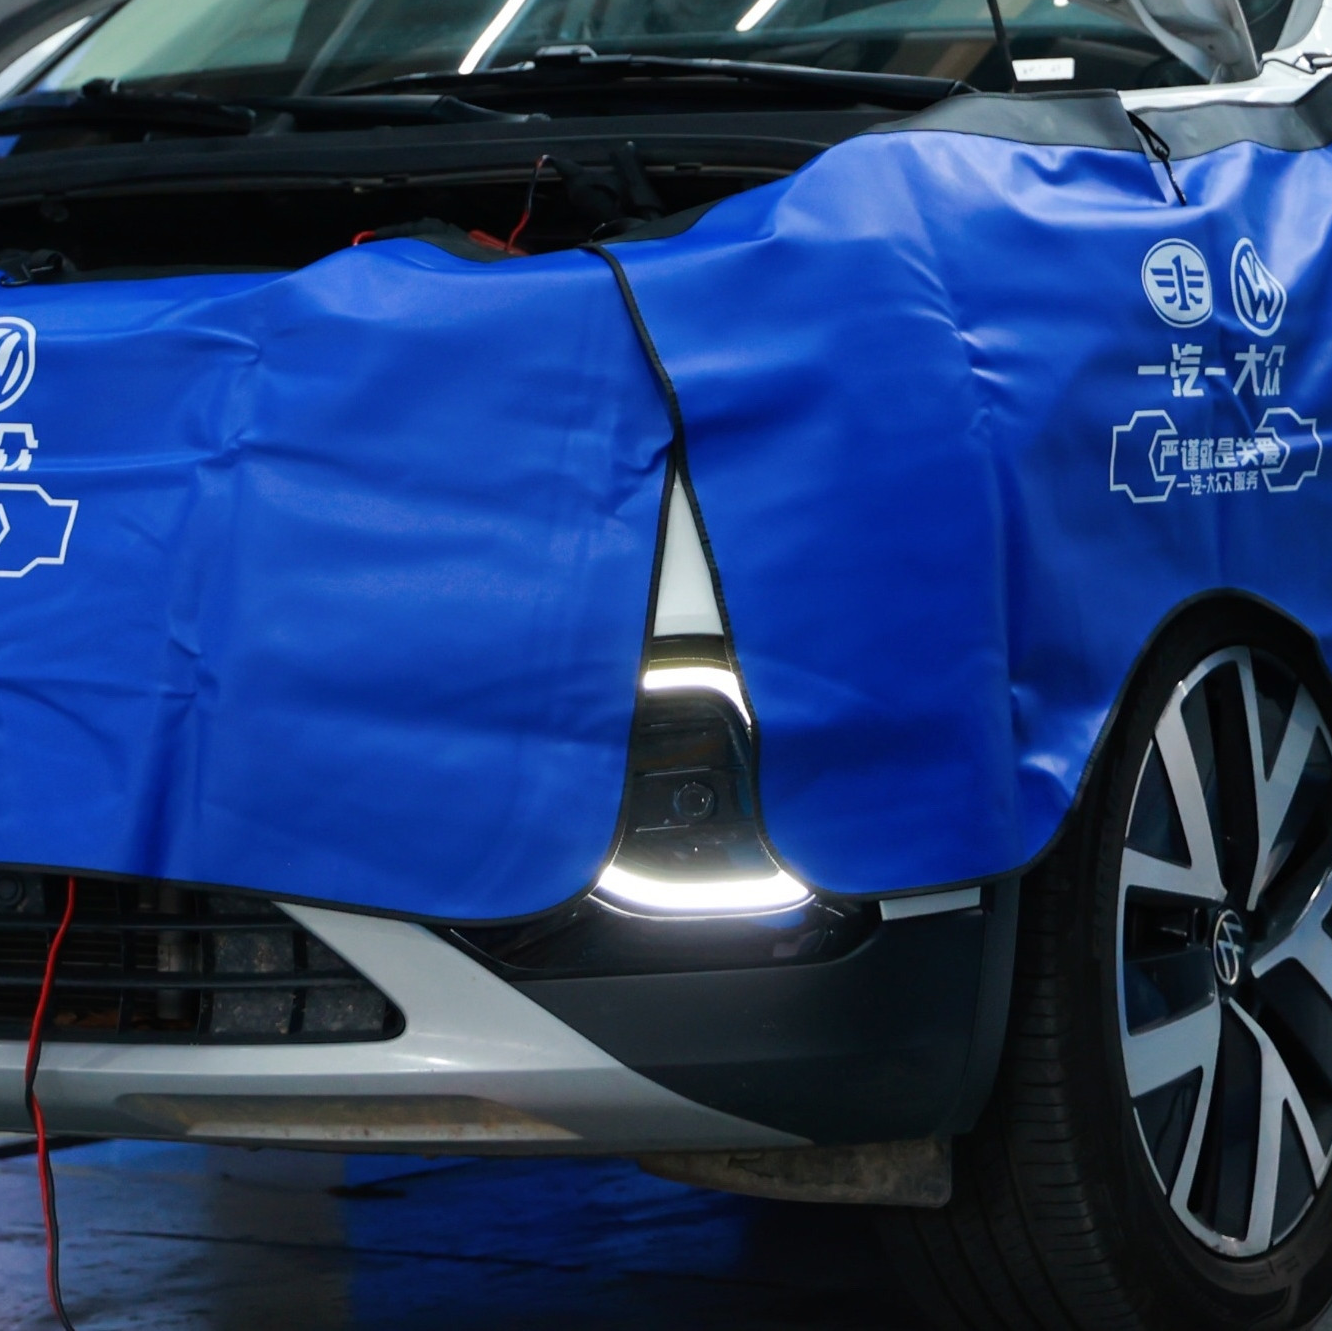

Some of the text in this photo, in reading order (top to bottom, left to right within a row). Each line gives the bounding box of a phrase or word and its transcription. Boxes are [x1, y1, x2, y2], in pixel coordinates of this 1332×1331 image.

[1160, 437, 1281, 472] 严谨就是关爱
